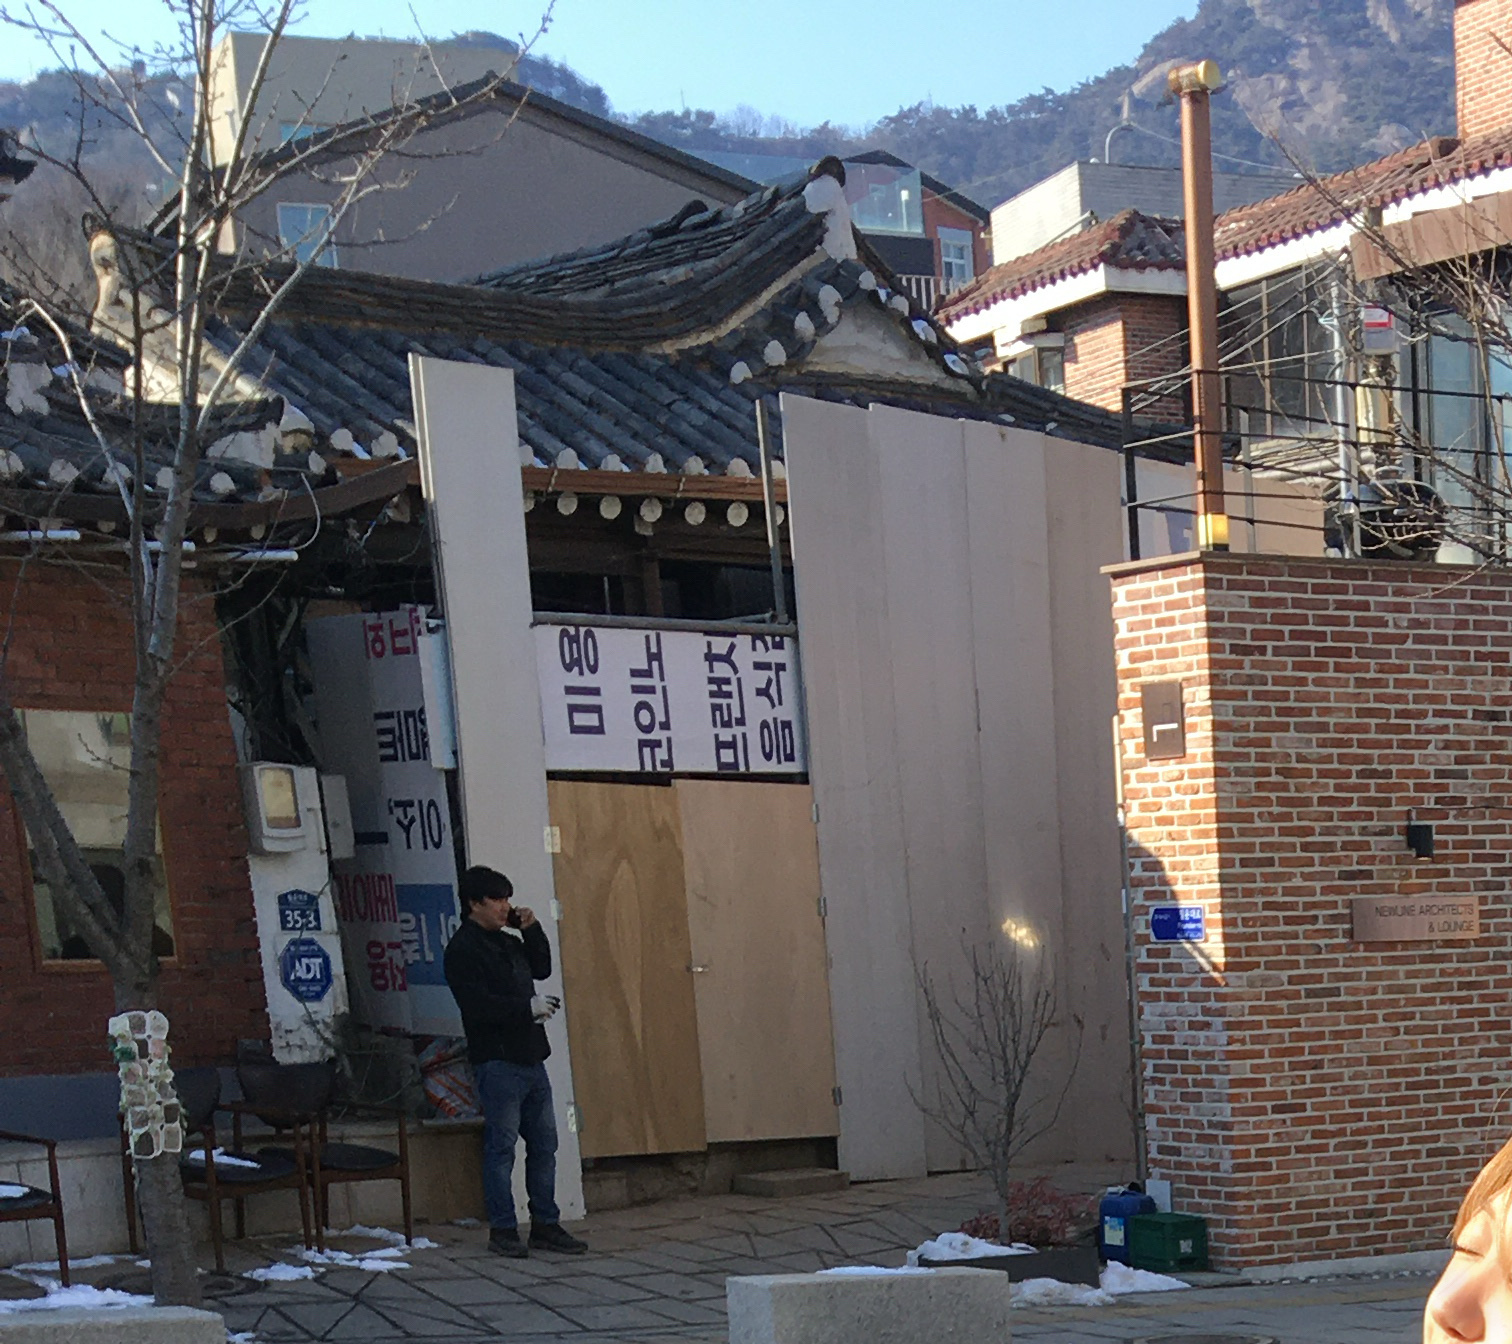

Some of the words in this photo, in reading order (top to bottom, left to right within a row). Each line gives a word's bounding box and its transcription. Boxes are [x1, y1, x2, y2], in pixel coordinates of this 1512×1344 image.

[558, 626, 606, 735] 미용
[285, 909, 317, 928] 35-3
[1419, 903, 1474, 916] ARCHITECTS
[1437, 920, 1474, 932] LOUNGE
[290, 957, 323, 980] ADT
